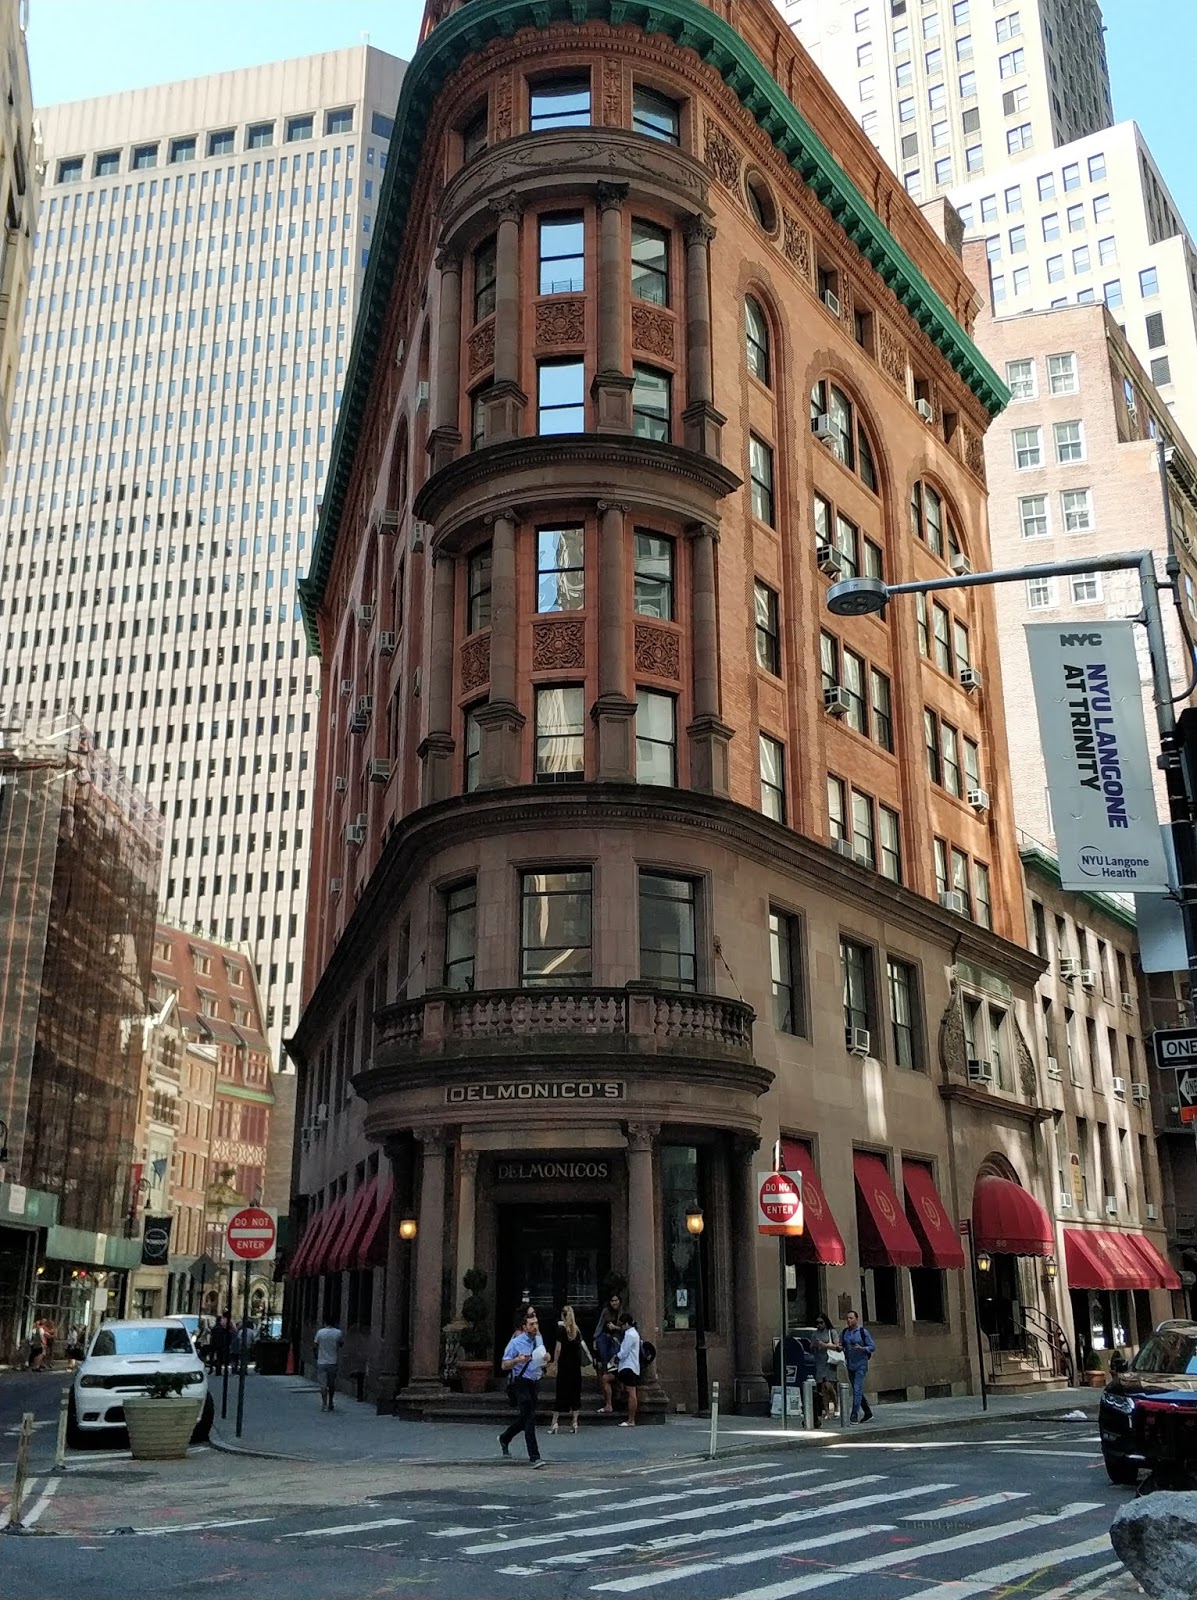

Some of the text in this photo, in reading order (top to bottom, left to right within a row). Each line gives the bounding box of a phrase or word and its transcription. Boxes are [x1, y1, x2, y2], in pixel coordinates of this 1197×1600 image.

[1060, 633, 1103, 647] NYC
[1063, 664, 1101, 792] AT TRINITY
[1086, 664, 1128, 829] NYU LANGONE
[1082, 855, 1149, 870] NYU Langone
[1102, 867, 1137, 878] Health
[1166, 1040, 1197, 1056] ONE
[450, 1083, 619, 1102] DELMONICO'S
[498, 1162, 608, 1179] DELMONICOS
[765, 1183, 794, 1192] DO NOT
[766, 1205, 794, 1214] ENTER
[234, 1217, 269, 1227] DO NOT
[236, 1240, 265, 1249] ENTER
